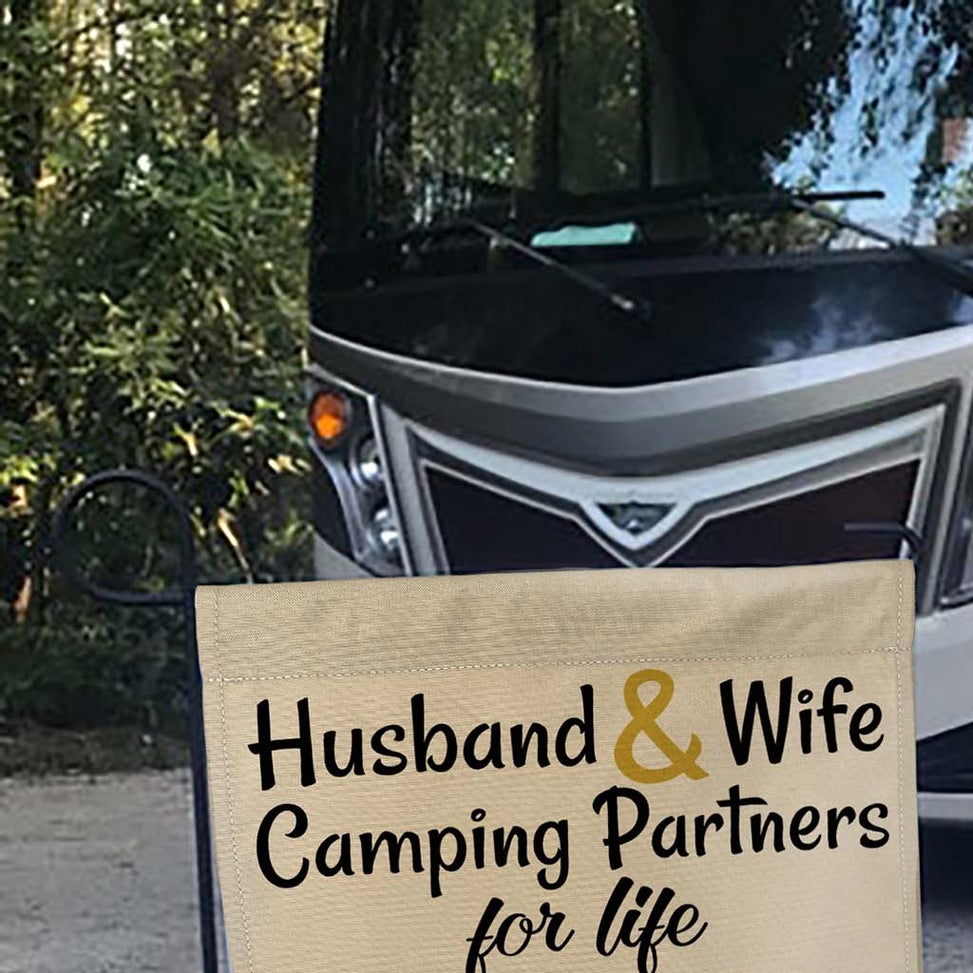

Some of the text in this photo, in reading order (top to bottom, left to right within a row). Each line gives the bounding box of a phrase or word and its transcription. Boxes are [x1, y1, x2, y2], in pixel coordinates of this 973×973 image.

[247, 668, 885, 791] Husband & Wife
[255, 784, 890, 899] Camping Partners
